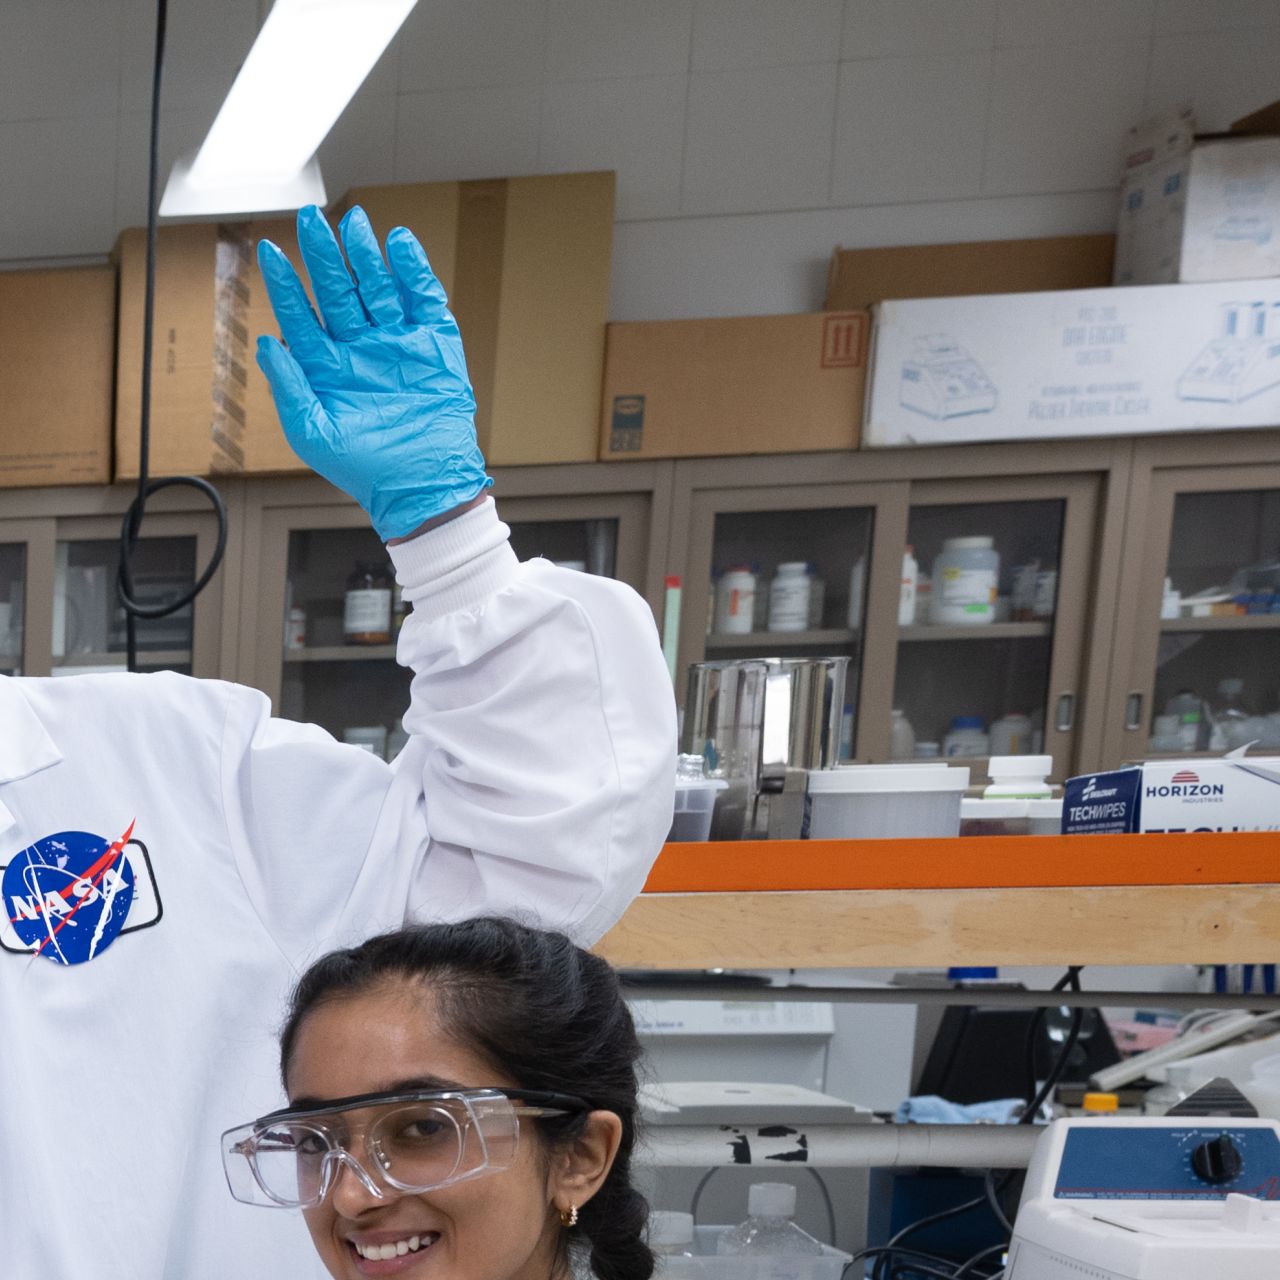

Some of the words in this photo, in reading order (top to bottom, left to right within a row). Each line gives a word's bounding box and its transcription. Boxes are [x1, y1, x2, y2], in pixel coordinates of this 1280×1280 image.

[1146, 784, 1224, 797] HORIZON
[1069, 802, 1126, 821] TECHWIPES
[11, 868, 129, 921] NASA
